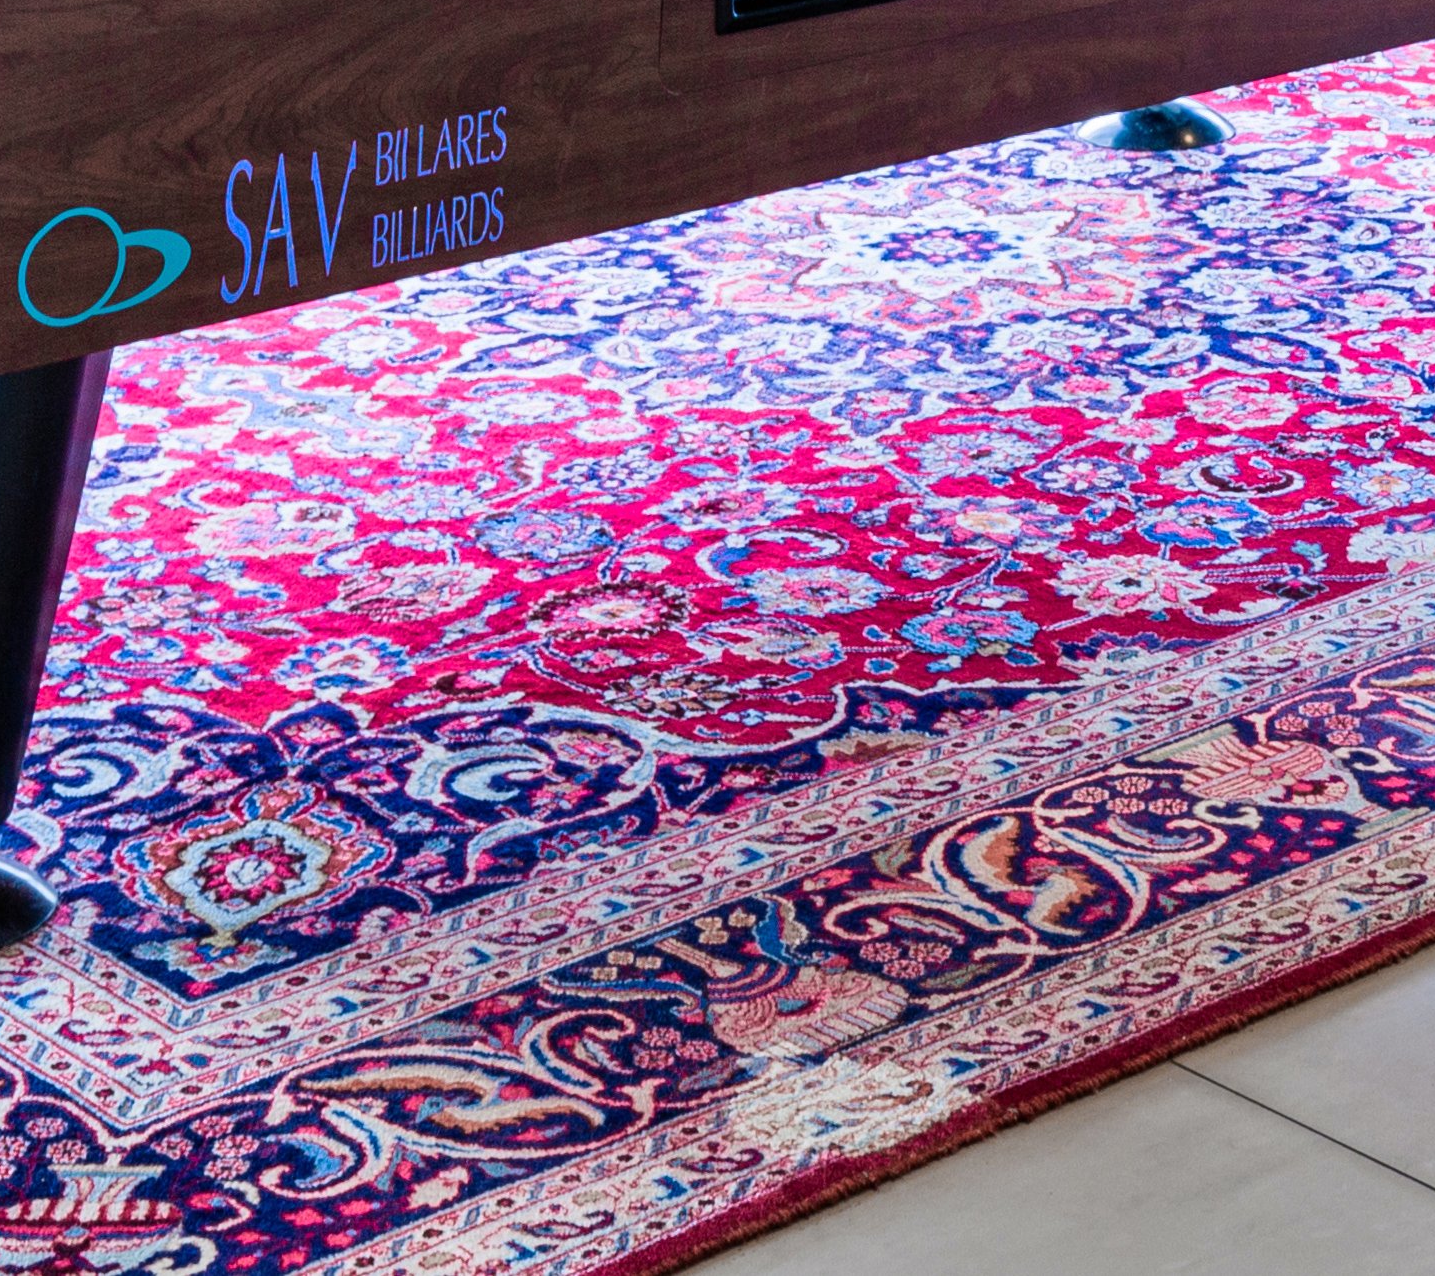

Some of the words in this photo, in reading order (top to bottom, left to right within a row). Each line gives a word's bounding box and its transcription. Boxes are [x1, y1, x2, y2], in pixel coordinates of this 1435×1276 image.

[374, 106, 507, 186] BILLARES
[220, 139, 357, 305] SAV
[371, 187, 504, 268] BILLIARDS
